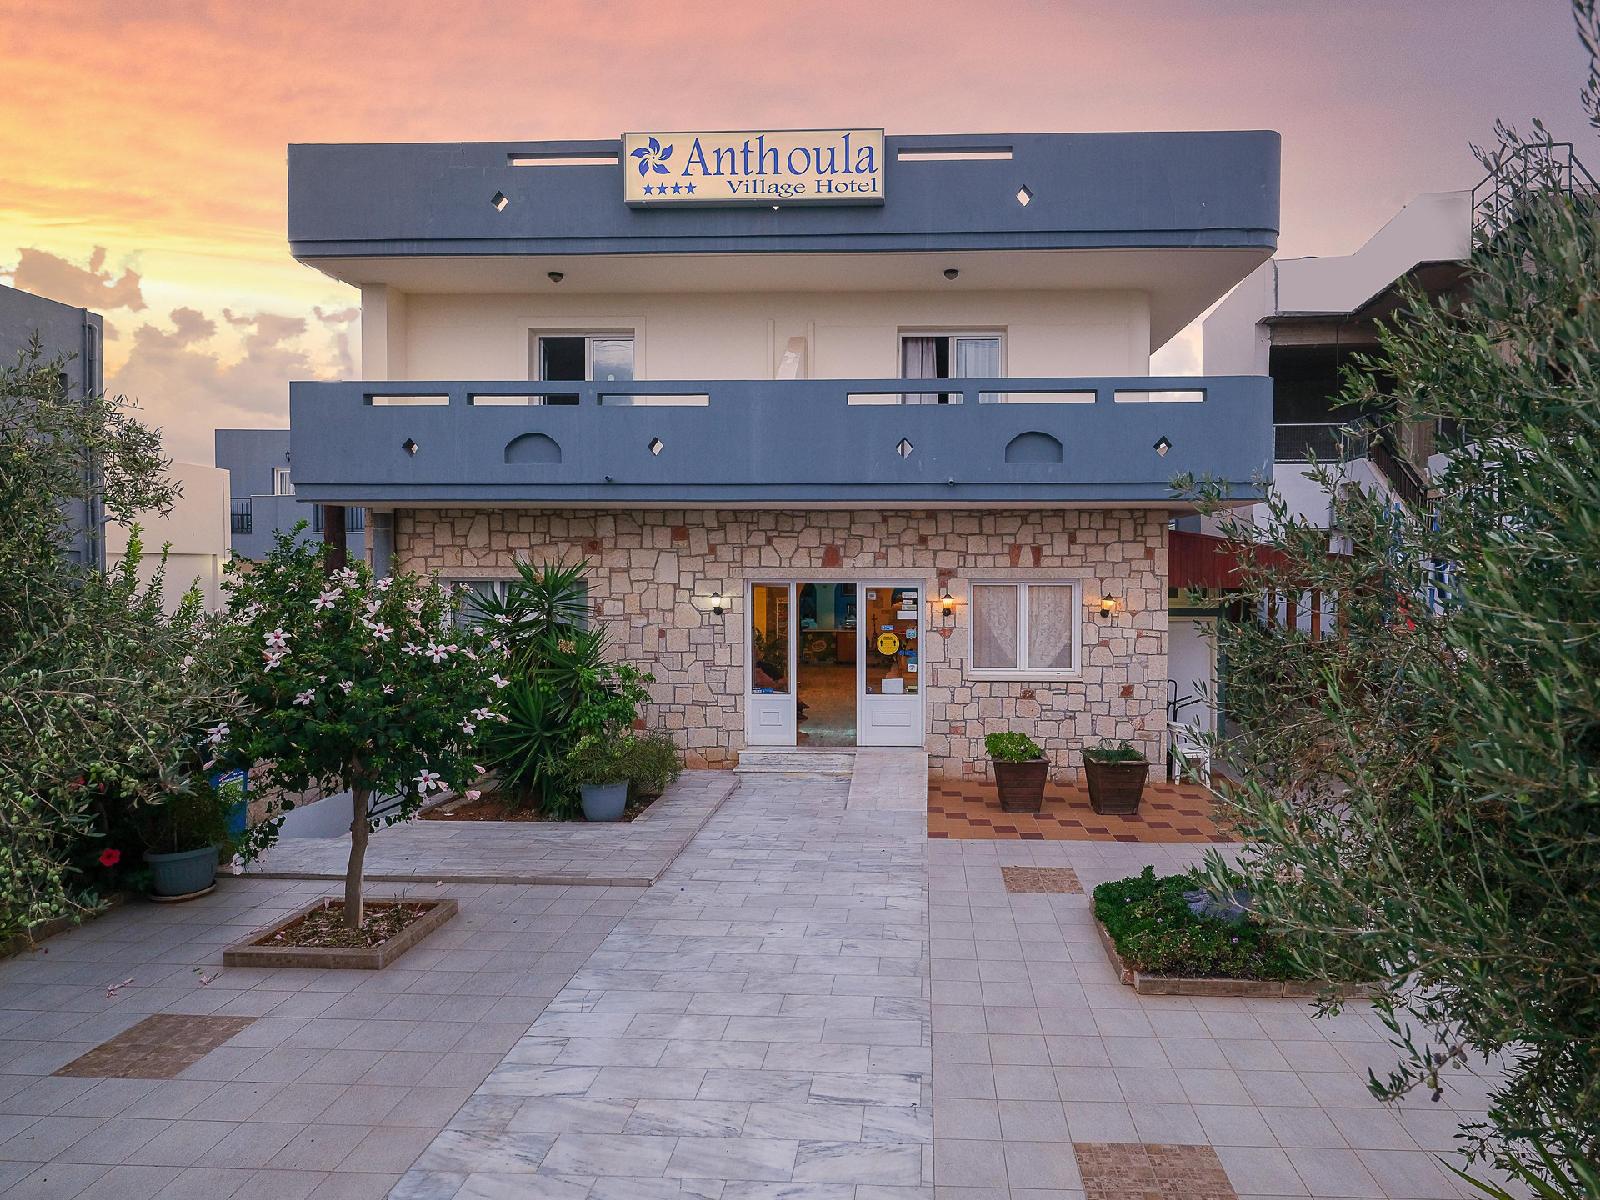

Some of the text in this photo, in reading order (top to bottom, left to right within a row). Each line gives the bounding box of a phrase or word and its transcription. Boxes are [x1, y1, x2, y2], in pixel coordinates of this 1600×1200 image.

[681, 132, 879, 176] Anthoula
[726, 177, 879, 198] Village Hotel
